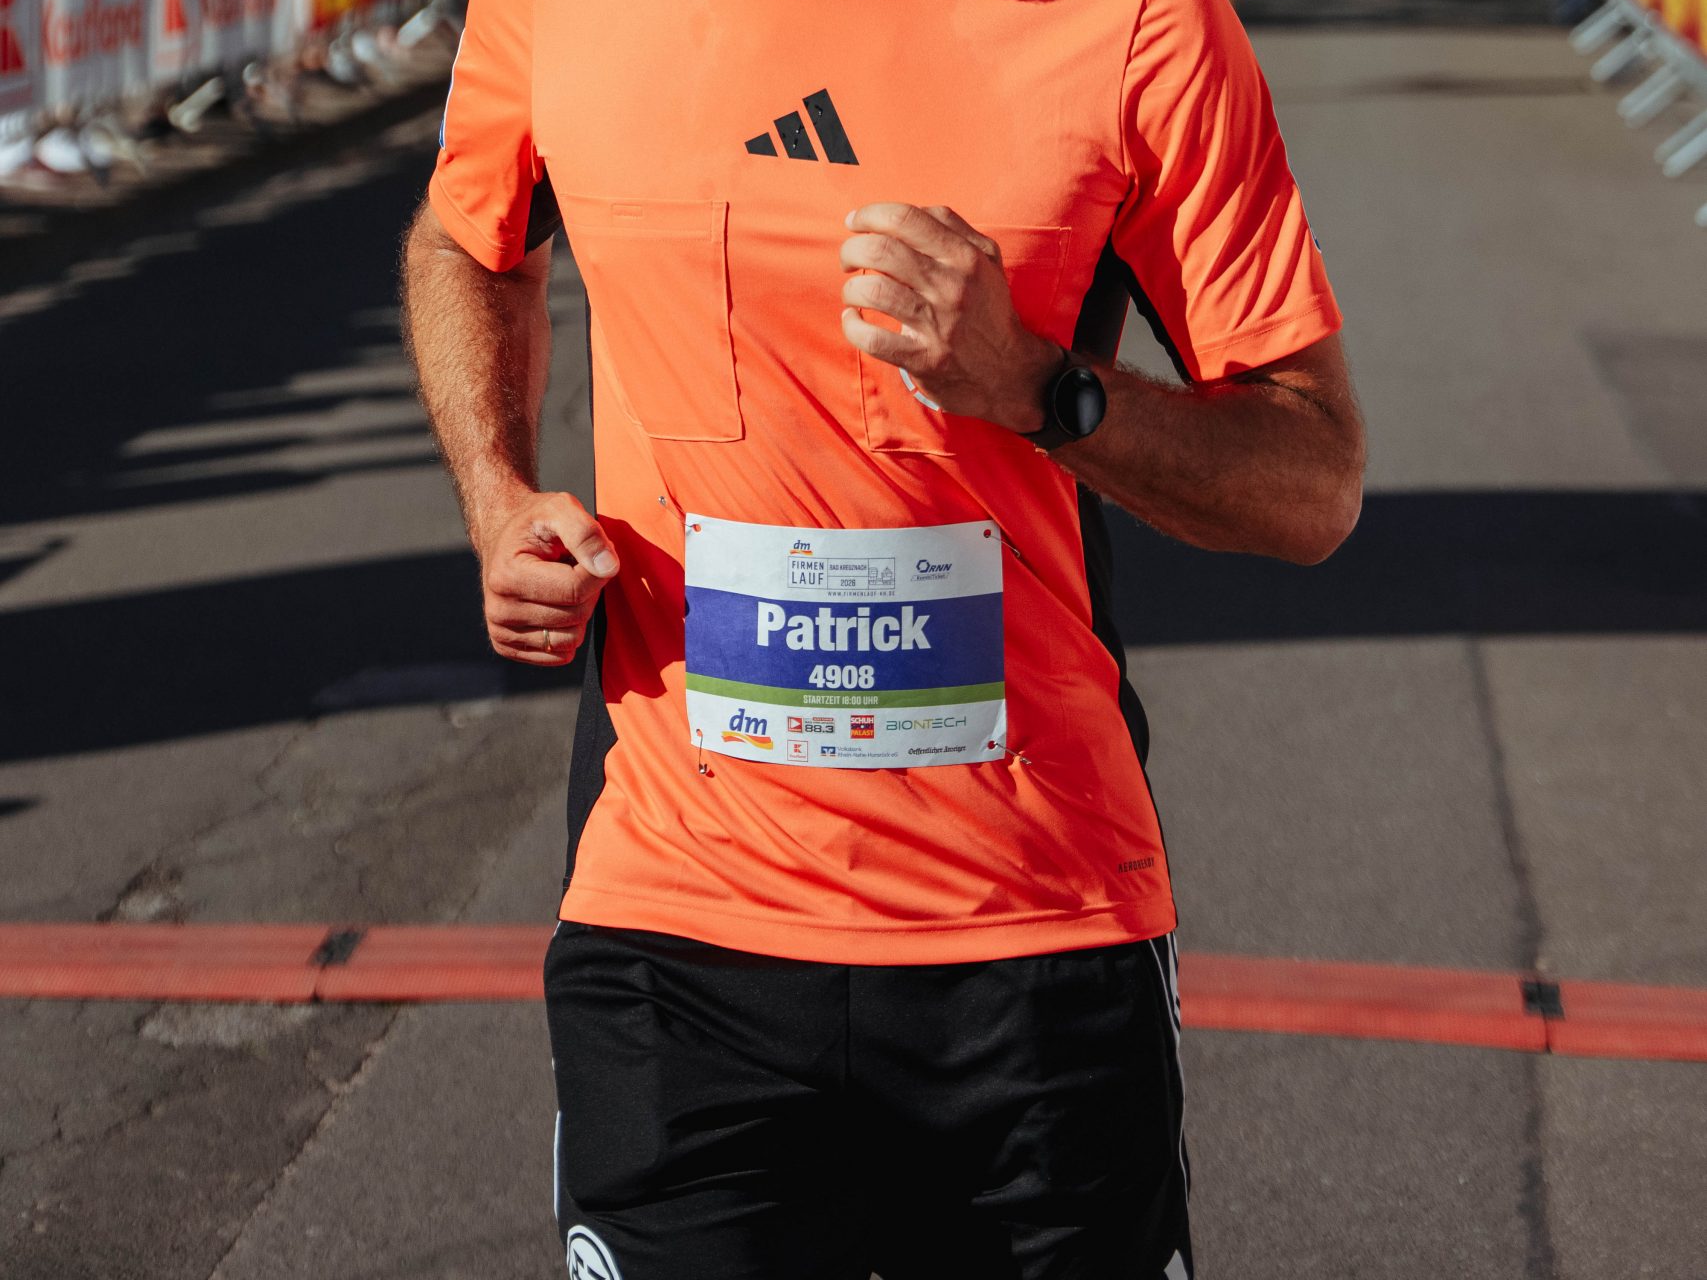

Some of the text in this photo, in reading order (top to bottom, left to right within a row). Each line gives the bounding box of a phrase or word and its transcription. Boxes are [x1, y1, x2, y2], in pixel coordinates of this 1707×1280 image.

[793, 540, 811, 551] dm
[791, 560, 825, 570] FIRMEN
[791, 572, 825, 585] LAUF
[757, 601, 932, 652] Patrick
[809, 664, 875, 689] 4908
[803, 694, 879, 705] STARTZEIT 18:00 UHR
[729, 708, 768, 735] dm
[886, 716, 967, 731] BIONTECH
[805, 724, 835, 733] 88.3
